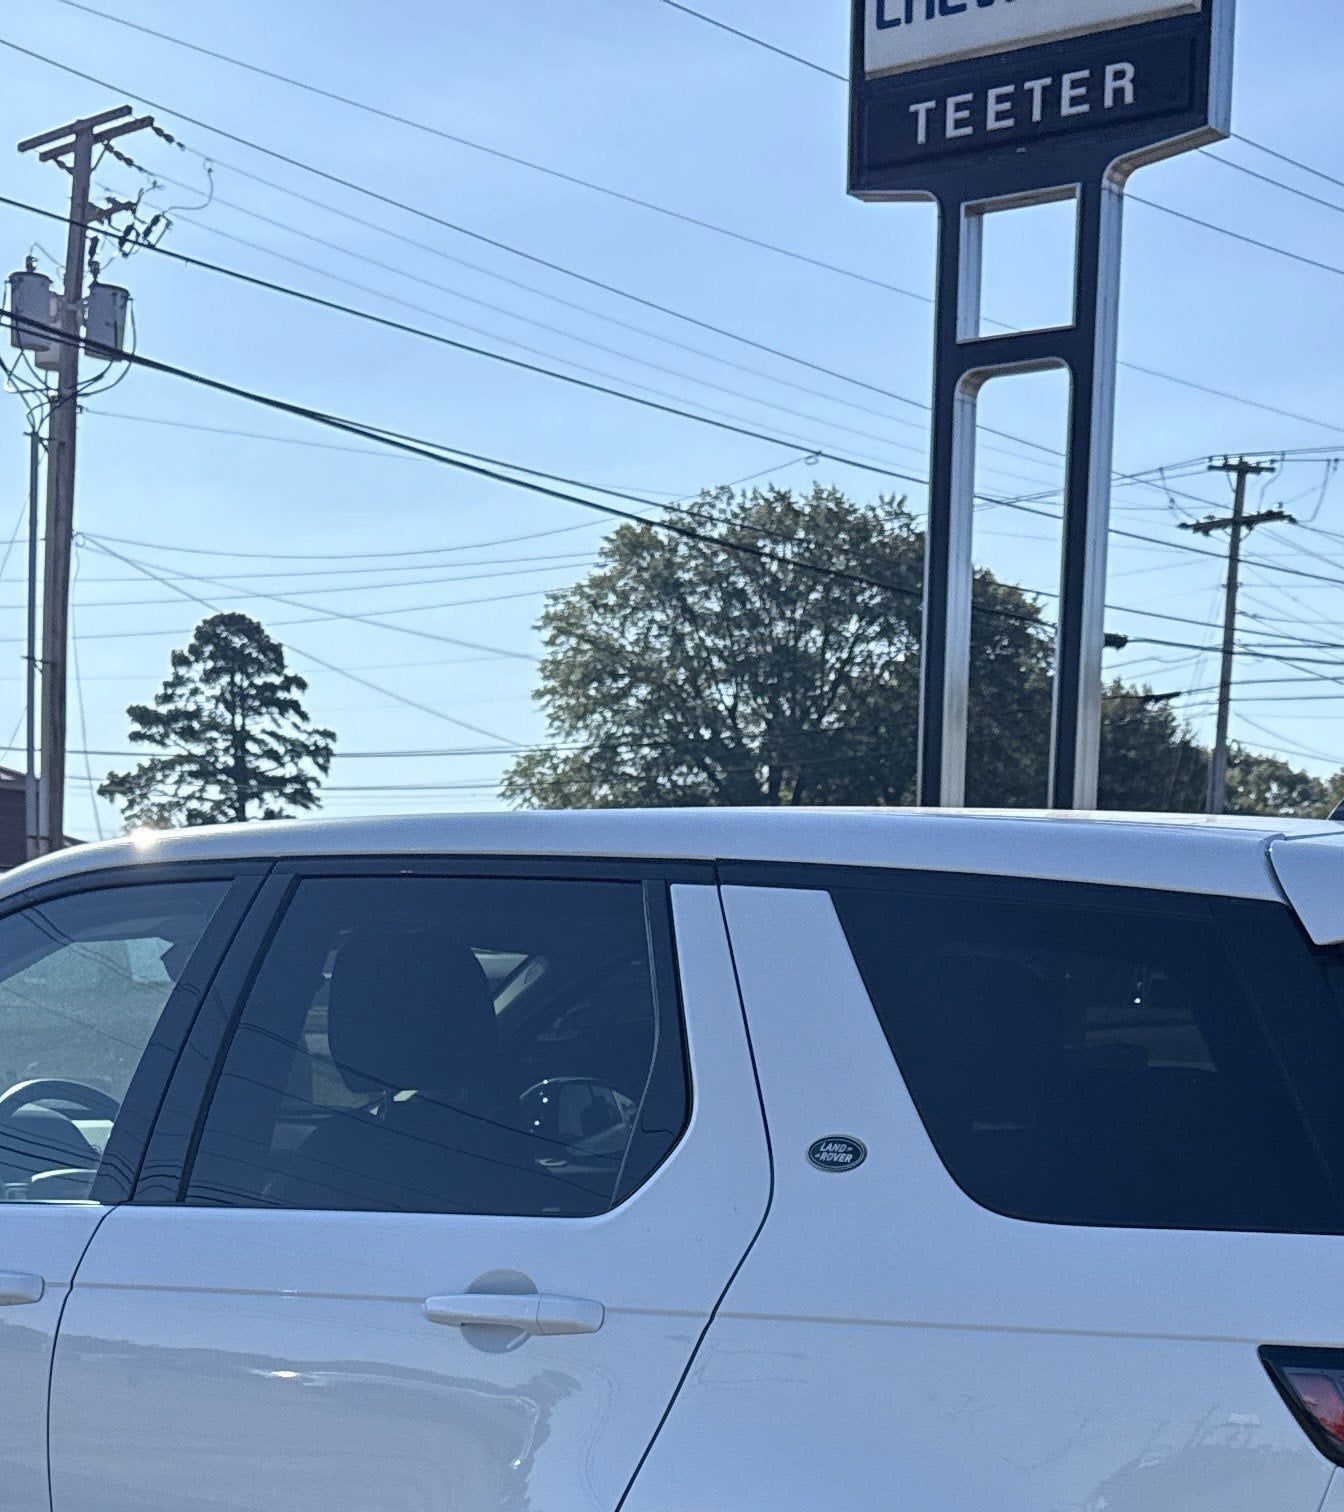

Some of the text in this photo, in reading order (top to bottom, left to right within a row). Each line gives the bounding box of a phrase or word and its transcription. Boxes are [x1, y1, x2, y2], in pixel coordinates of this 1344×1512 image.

[909, 61, 1137, 145] TEETER
[820, 1140, 847, 1152] LAND
[820, 1152, 853, 1163] ROVER
